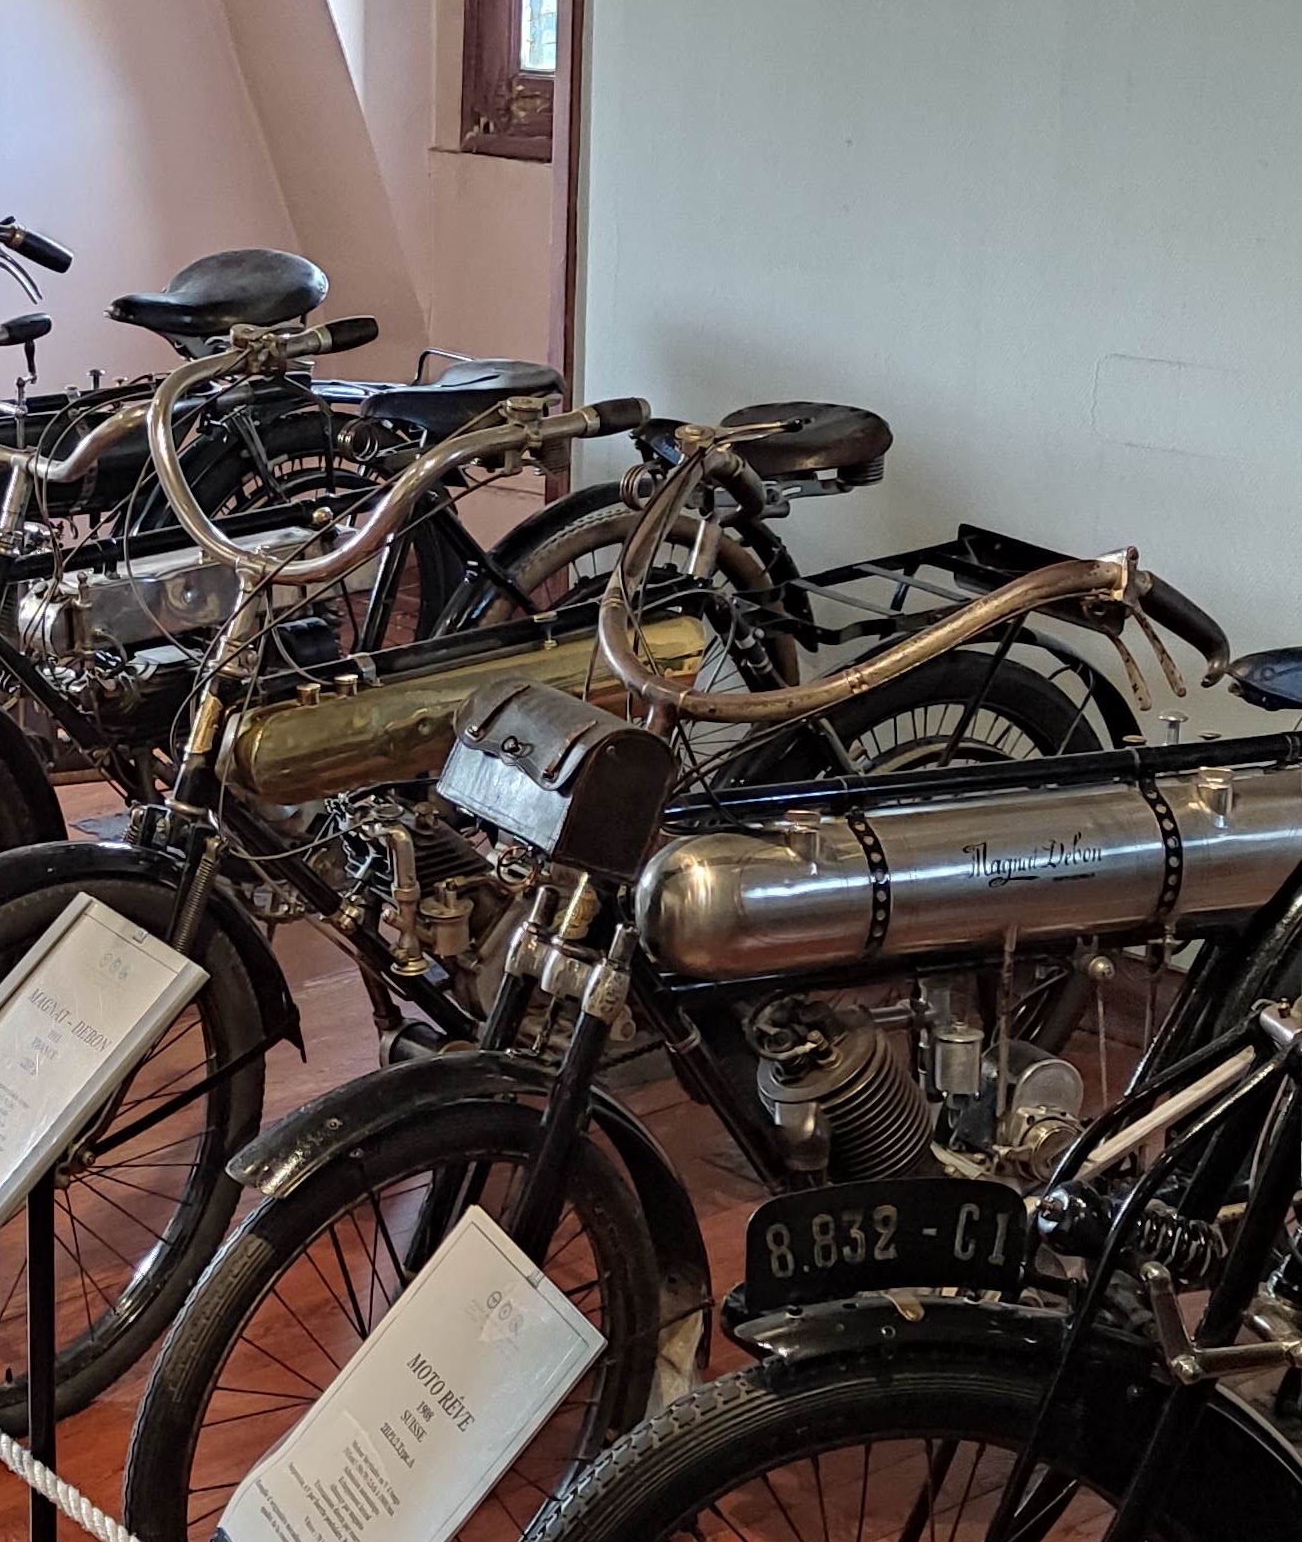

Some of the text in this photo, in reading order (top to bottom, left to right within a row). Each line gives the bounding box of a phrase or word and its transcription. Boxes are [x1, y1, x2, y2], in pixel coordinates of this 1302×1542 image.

[26, 986, 72, 1026] MAGNAT
[69, 1018, 112, 1055] DEBON
[398, 1407, 428, 1444] SUISSE
[406, 1348, 480, 1436] MOTO RÊVE
